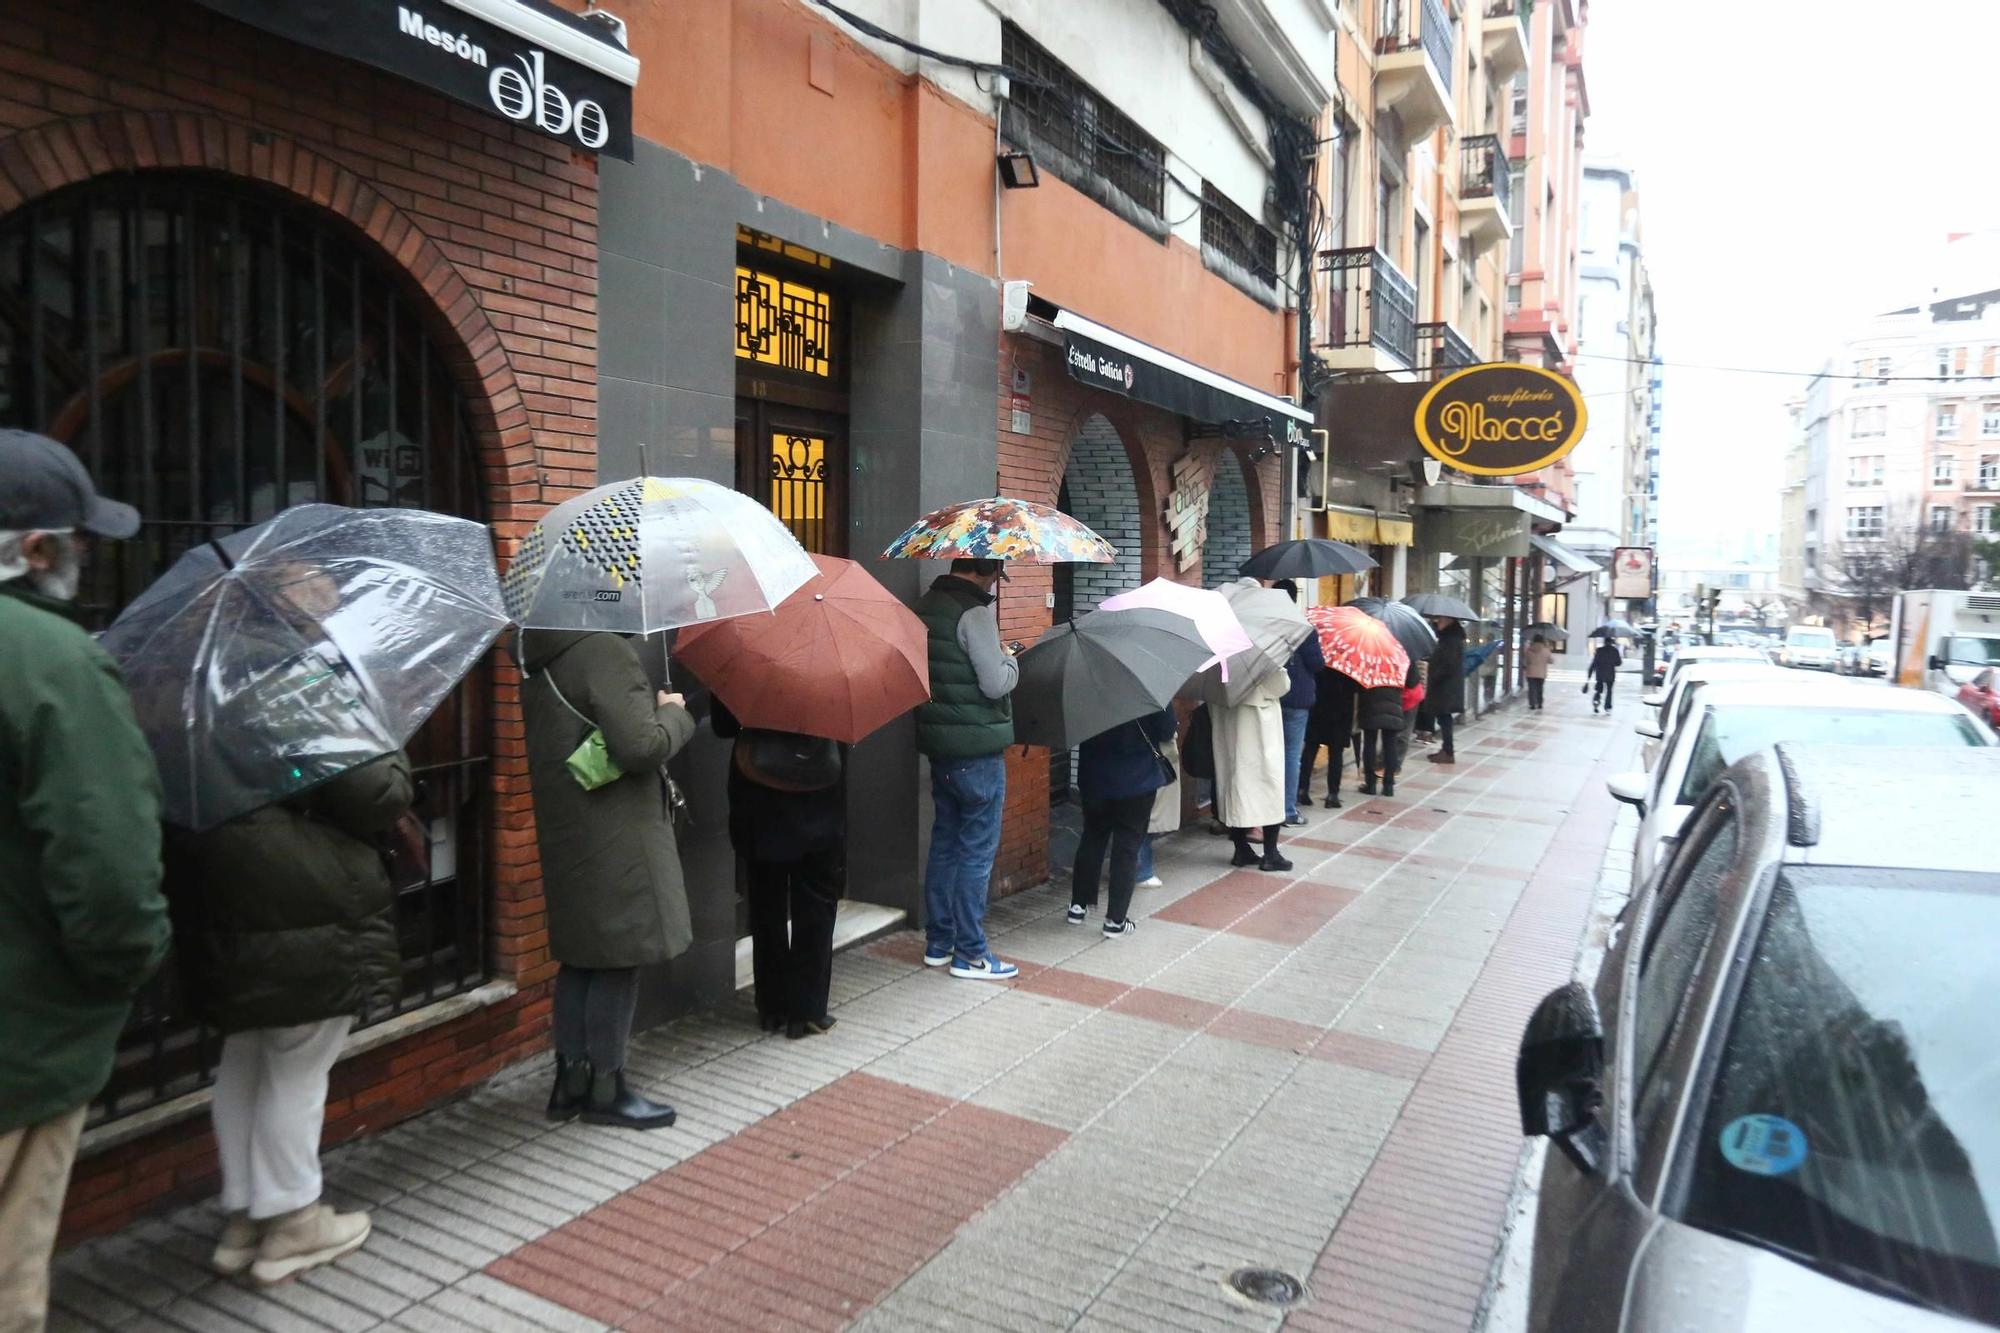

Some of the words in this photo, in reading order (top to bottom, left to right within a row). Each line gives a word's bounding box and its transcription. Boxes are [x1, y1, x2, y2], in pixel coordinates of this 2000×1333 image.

[397, 6, 488, 68] Mesón
[1068, 344, 1096, 373] Estrella
[1098, 356, 1123, 382] Galicia
